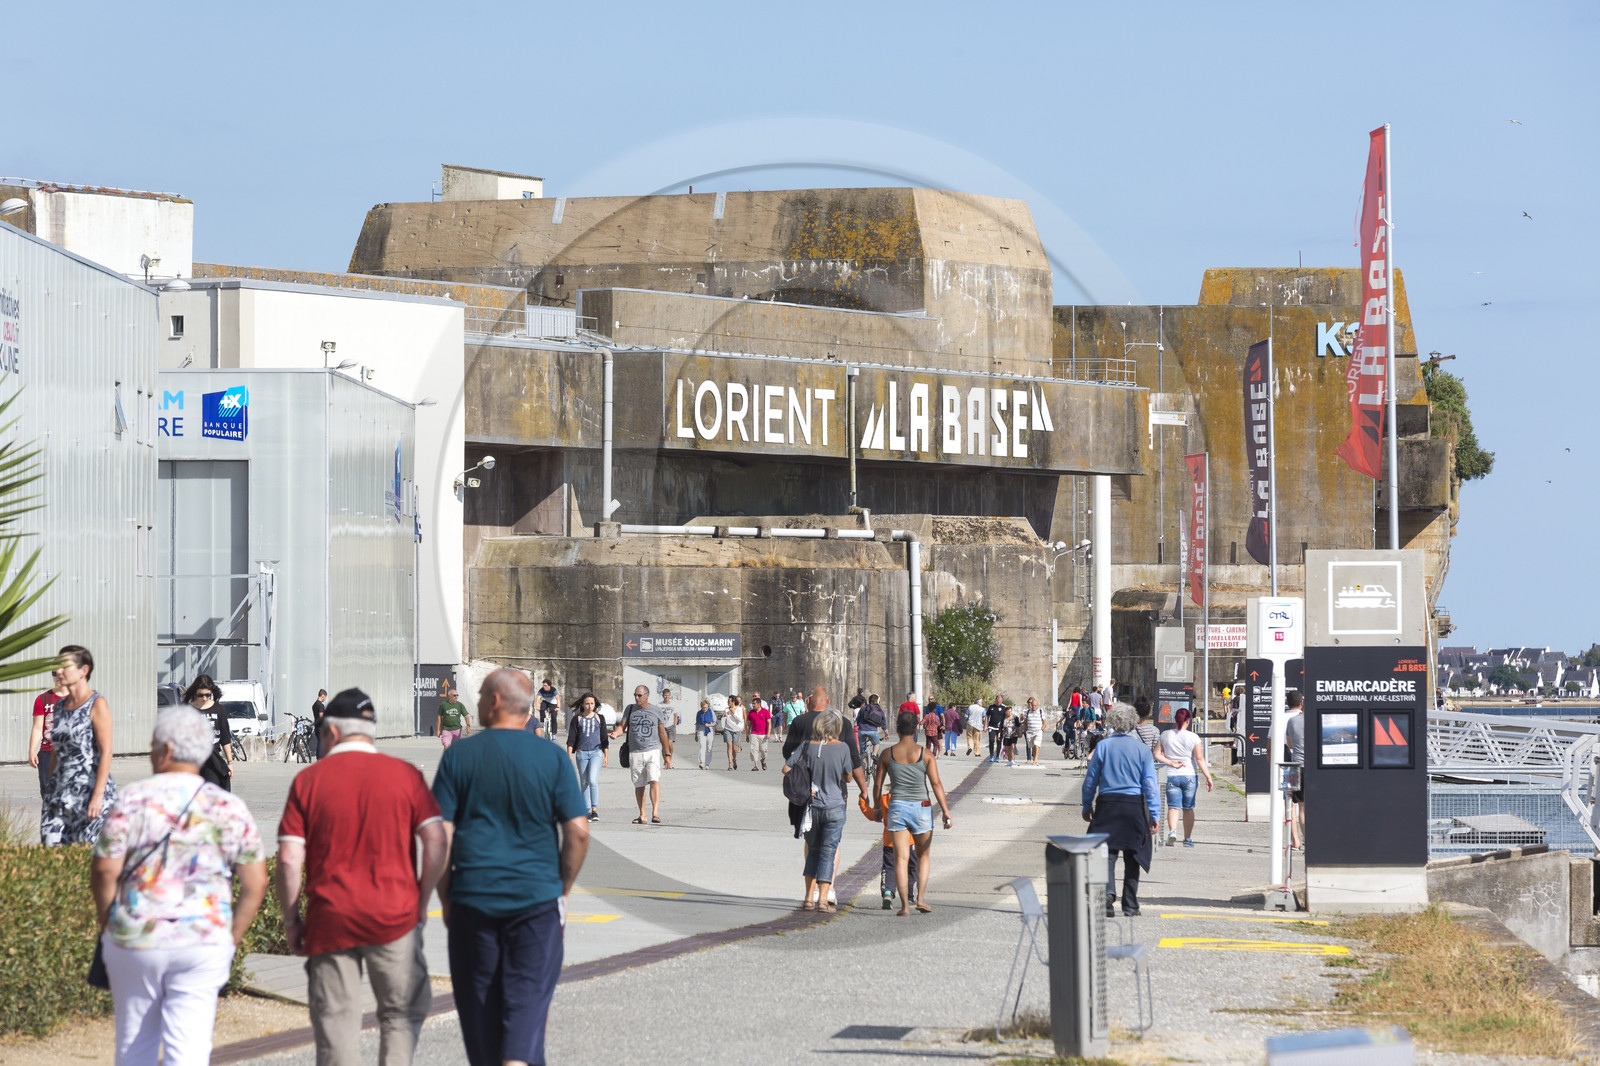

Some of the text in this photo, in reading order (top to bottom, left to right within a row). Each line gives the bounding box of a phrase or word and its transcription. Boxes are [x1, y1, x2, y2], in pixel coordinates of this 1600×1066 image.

[1359, 346, 1386, 405] LA
[676, 378, 836, 446] LORIENT
[204, 421, 243, 430] BANQUE
[889, 380, 1028, 459] LA BASE
[203, 428, 243, 439] POPULAIRE
[1250, 382, 1269, 519] LA BASE
[655, 636, 683, 646] MUSÉE
[1398, 664, 1427, 672] LA BASE
[1316, 677, 1416, 692] EMBARCADÈRE
[1316, 694, 1334, 702] BOAT
[1335, 694, 1369, 702] TERMINAL
